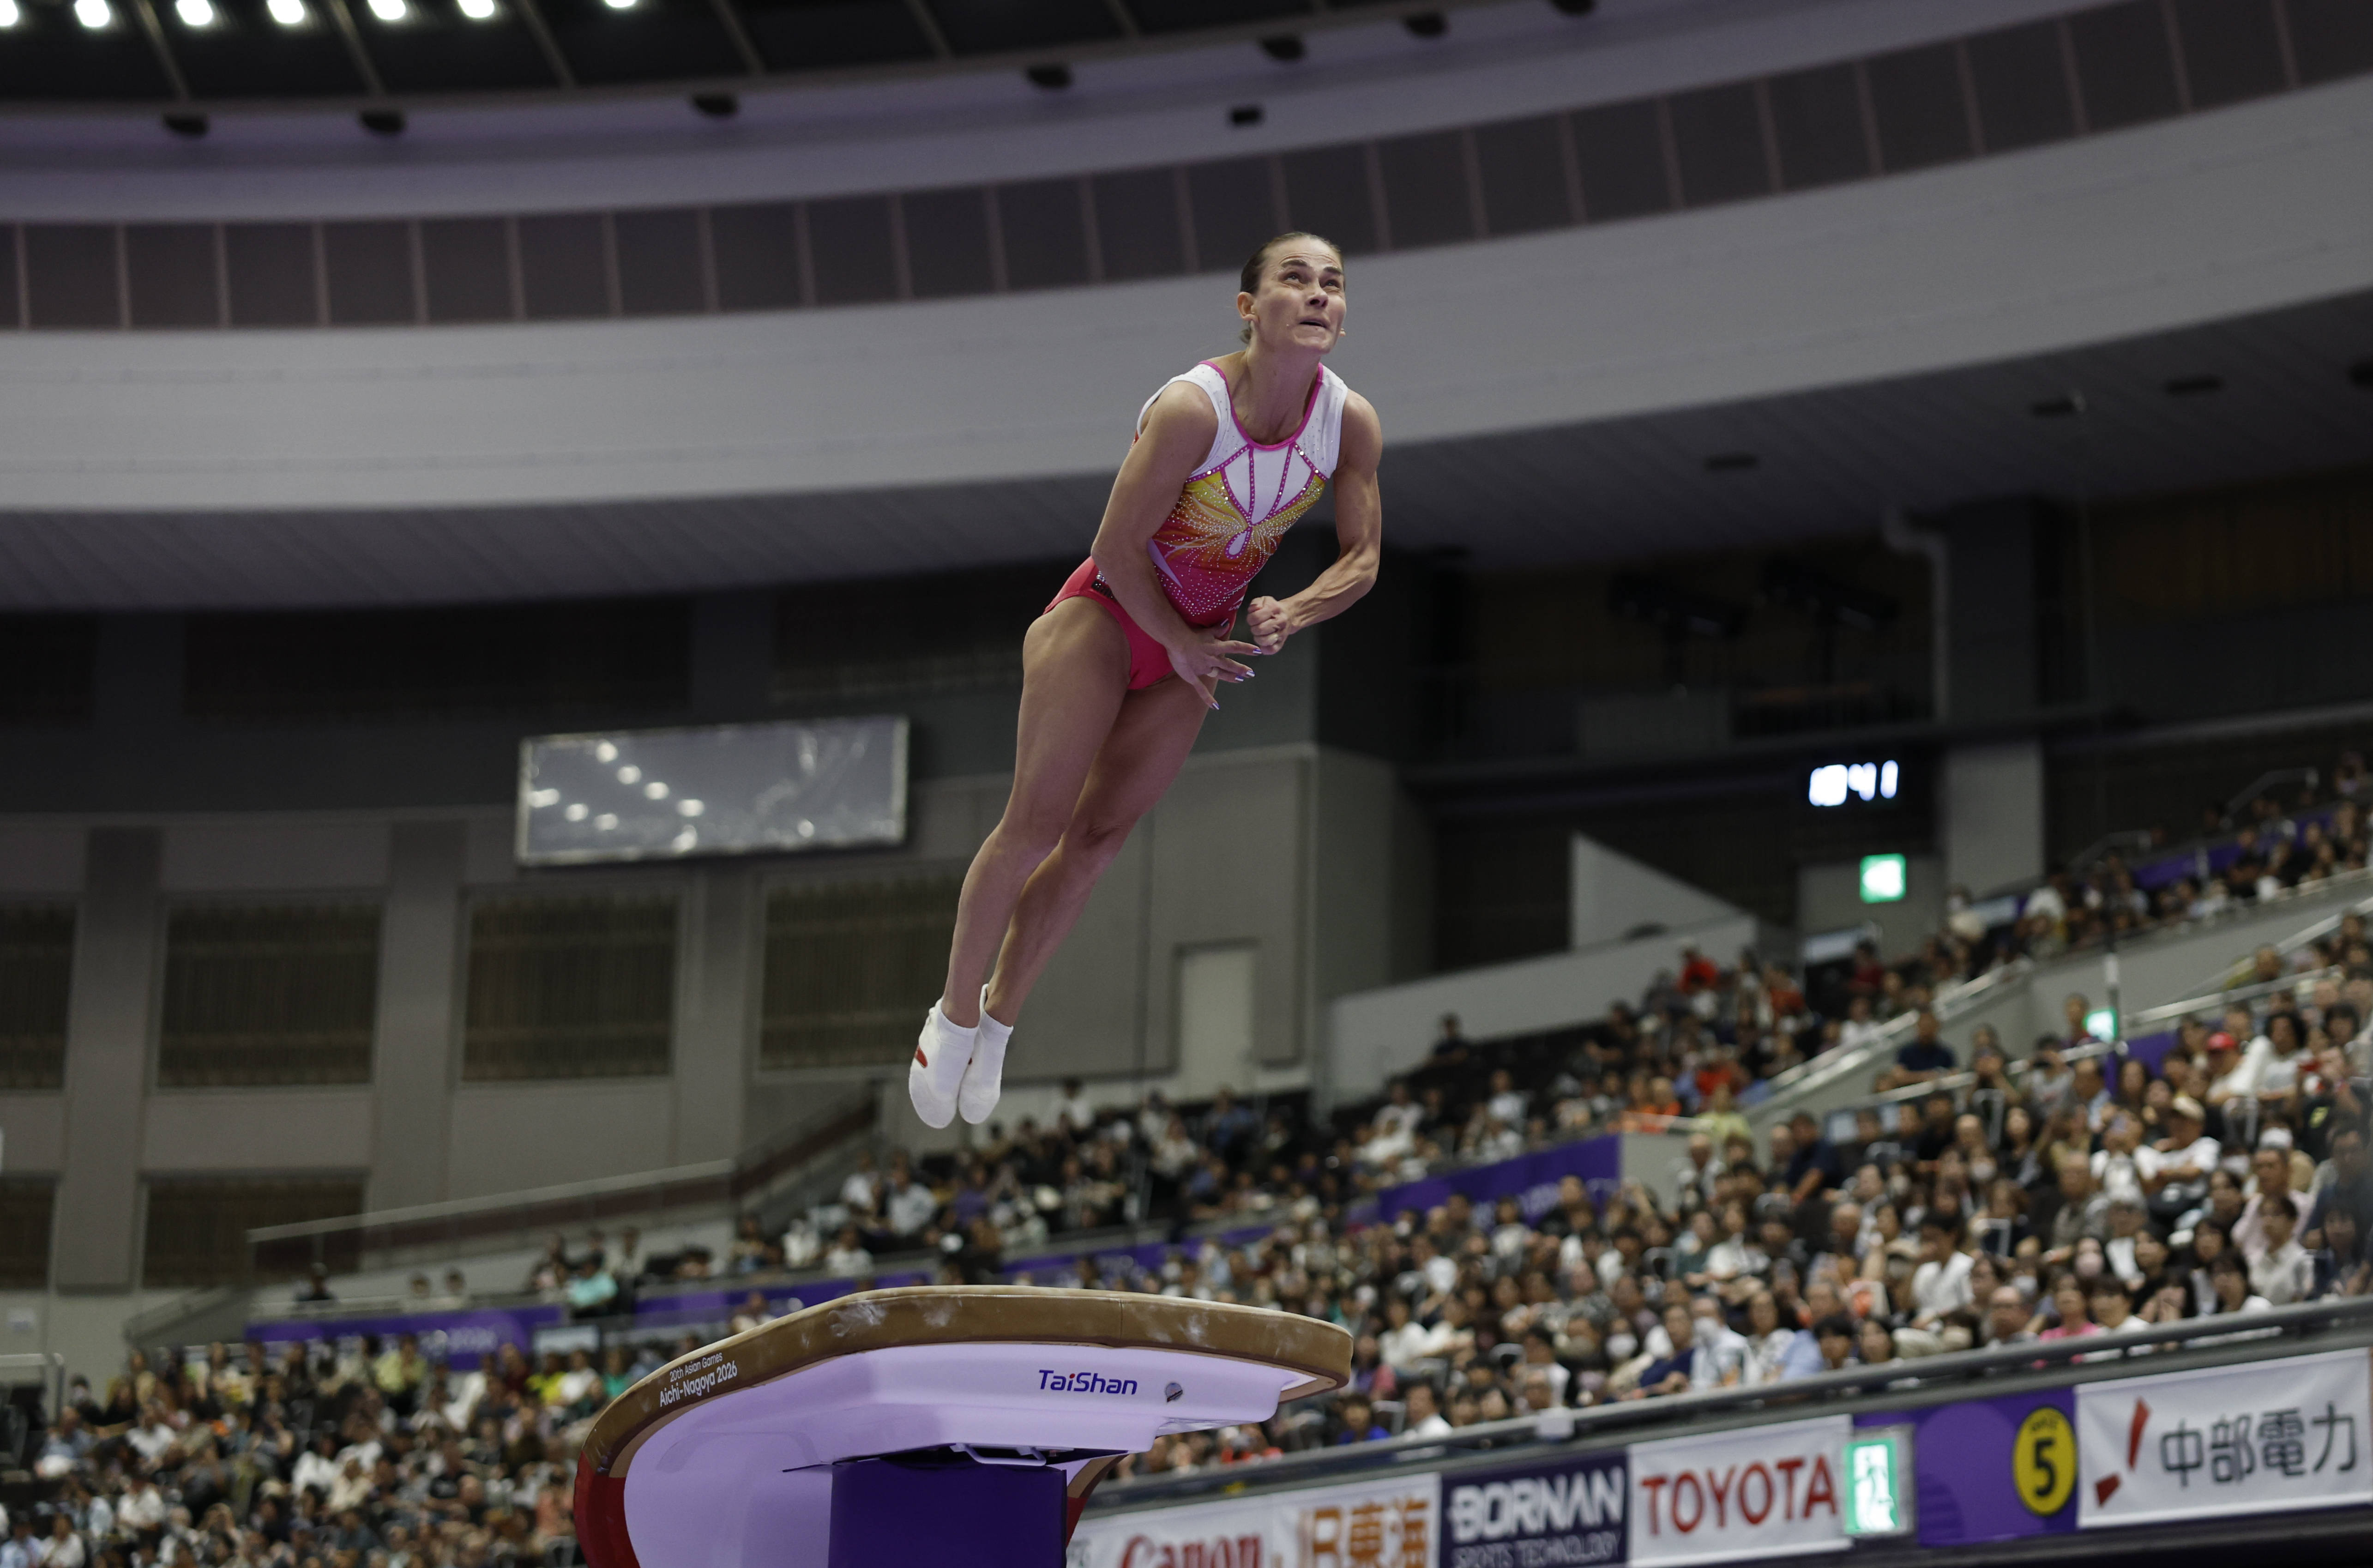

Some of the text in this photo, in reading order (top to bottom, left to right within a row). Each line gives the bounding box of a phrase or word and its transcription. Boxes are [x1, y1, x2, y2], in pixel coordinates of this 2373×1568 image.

[659, 1360, 738, 1407] Aichi-Nagoya 2026
[669, 1352, 723, 1382] 20th Asian Games
[1039, 1369, 1138, 1395] TaiShan
[2034, 1437, 2057, 1497] 5
[2160, 1400, 2357, 1490] 中部電力
[1448, 1465, 1625, 1543] BORNAN
[1640, 1453, 1837, 1536] TOYOTA
